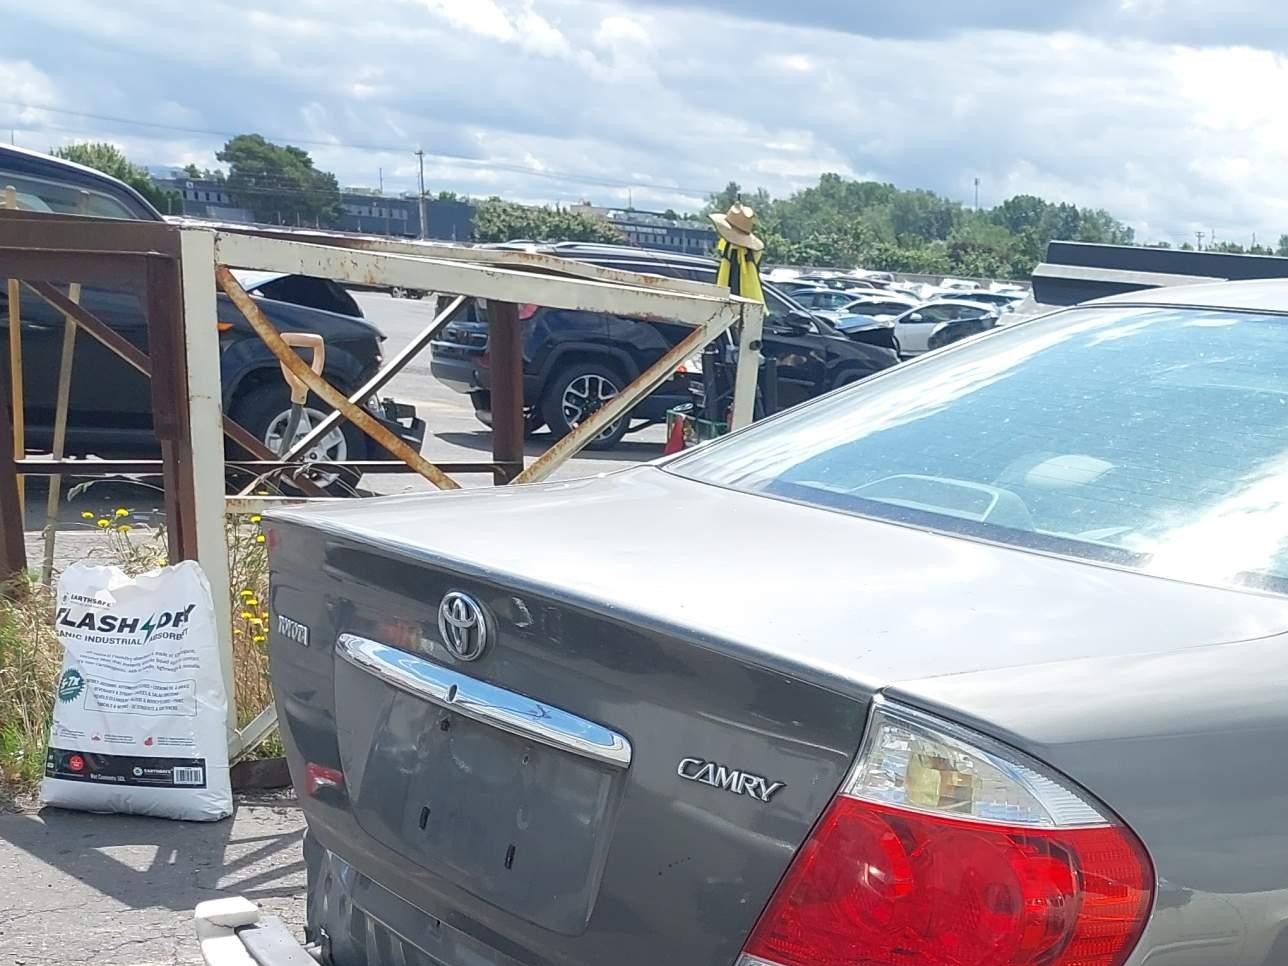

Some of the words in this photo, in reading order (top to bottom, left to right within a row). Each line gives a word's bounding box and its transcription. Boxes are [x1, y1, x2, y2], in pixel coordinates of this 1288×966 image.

[84, 635, 142, 646] INDUSTRIAL
[277, 615, 310, 647] TOYOTA
[677, 757, 787, 803] CAMRY
